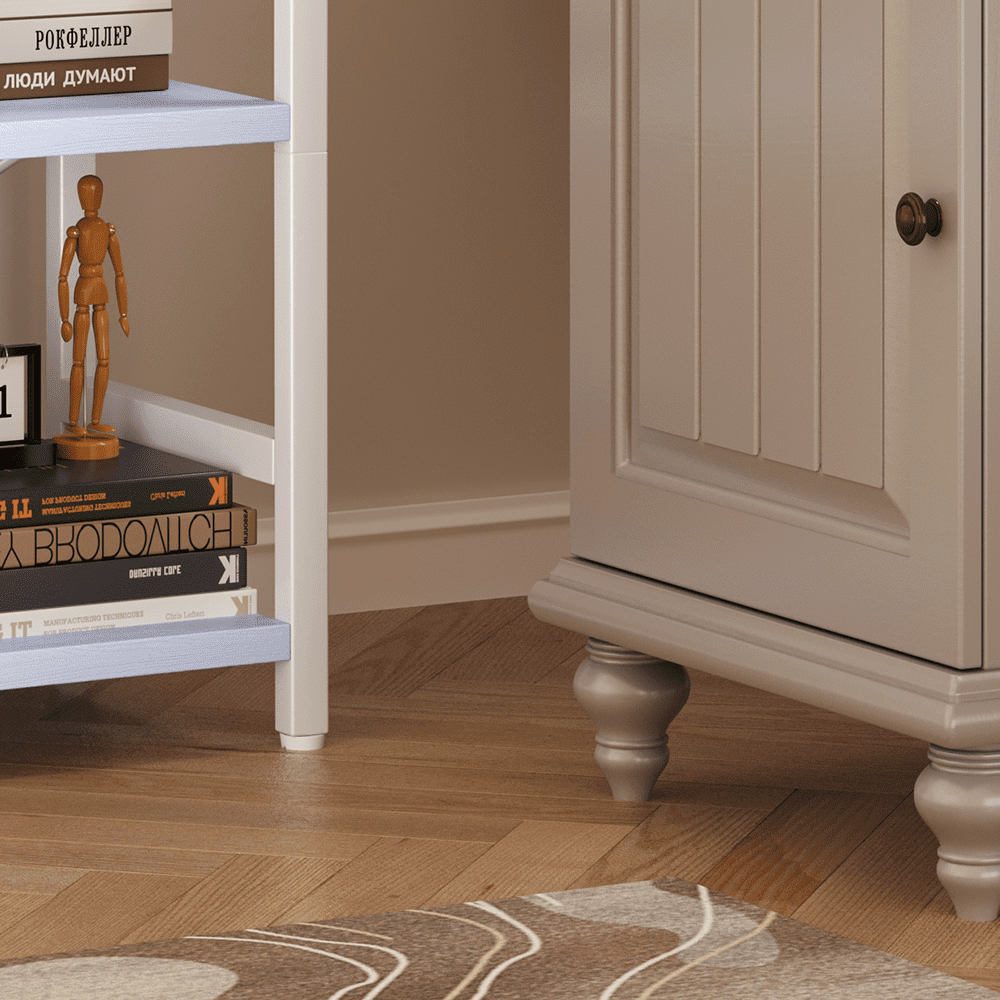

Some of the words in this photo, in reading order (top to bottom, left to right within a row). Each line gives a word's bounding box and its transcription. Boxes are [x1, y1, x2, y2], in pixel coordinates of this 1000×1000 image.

[35, 25, 132, 50] РОКФЕЛЛЕР
[4, 72, 56, 90] ЛЮДИ
[63, 67, 137, 87] ДУМАЮТ
[44, 615, 101, 627] MANUFACTURING
[103, 611, 144, 621] TECHNIQUES
[165, 611, 183, 620] Chris
[10, 620, 32, 638] IT
